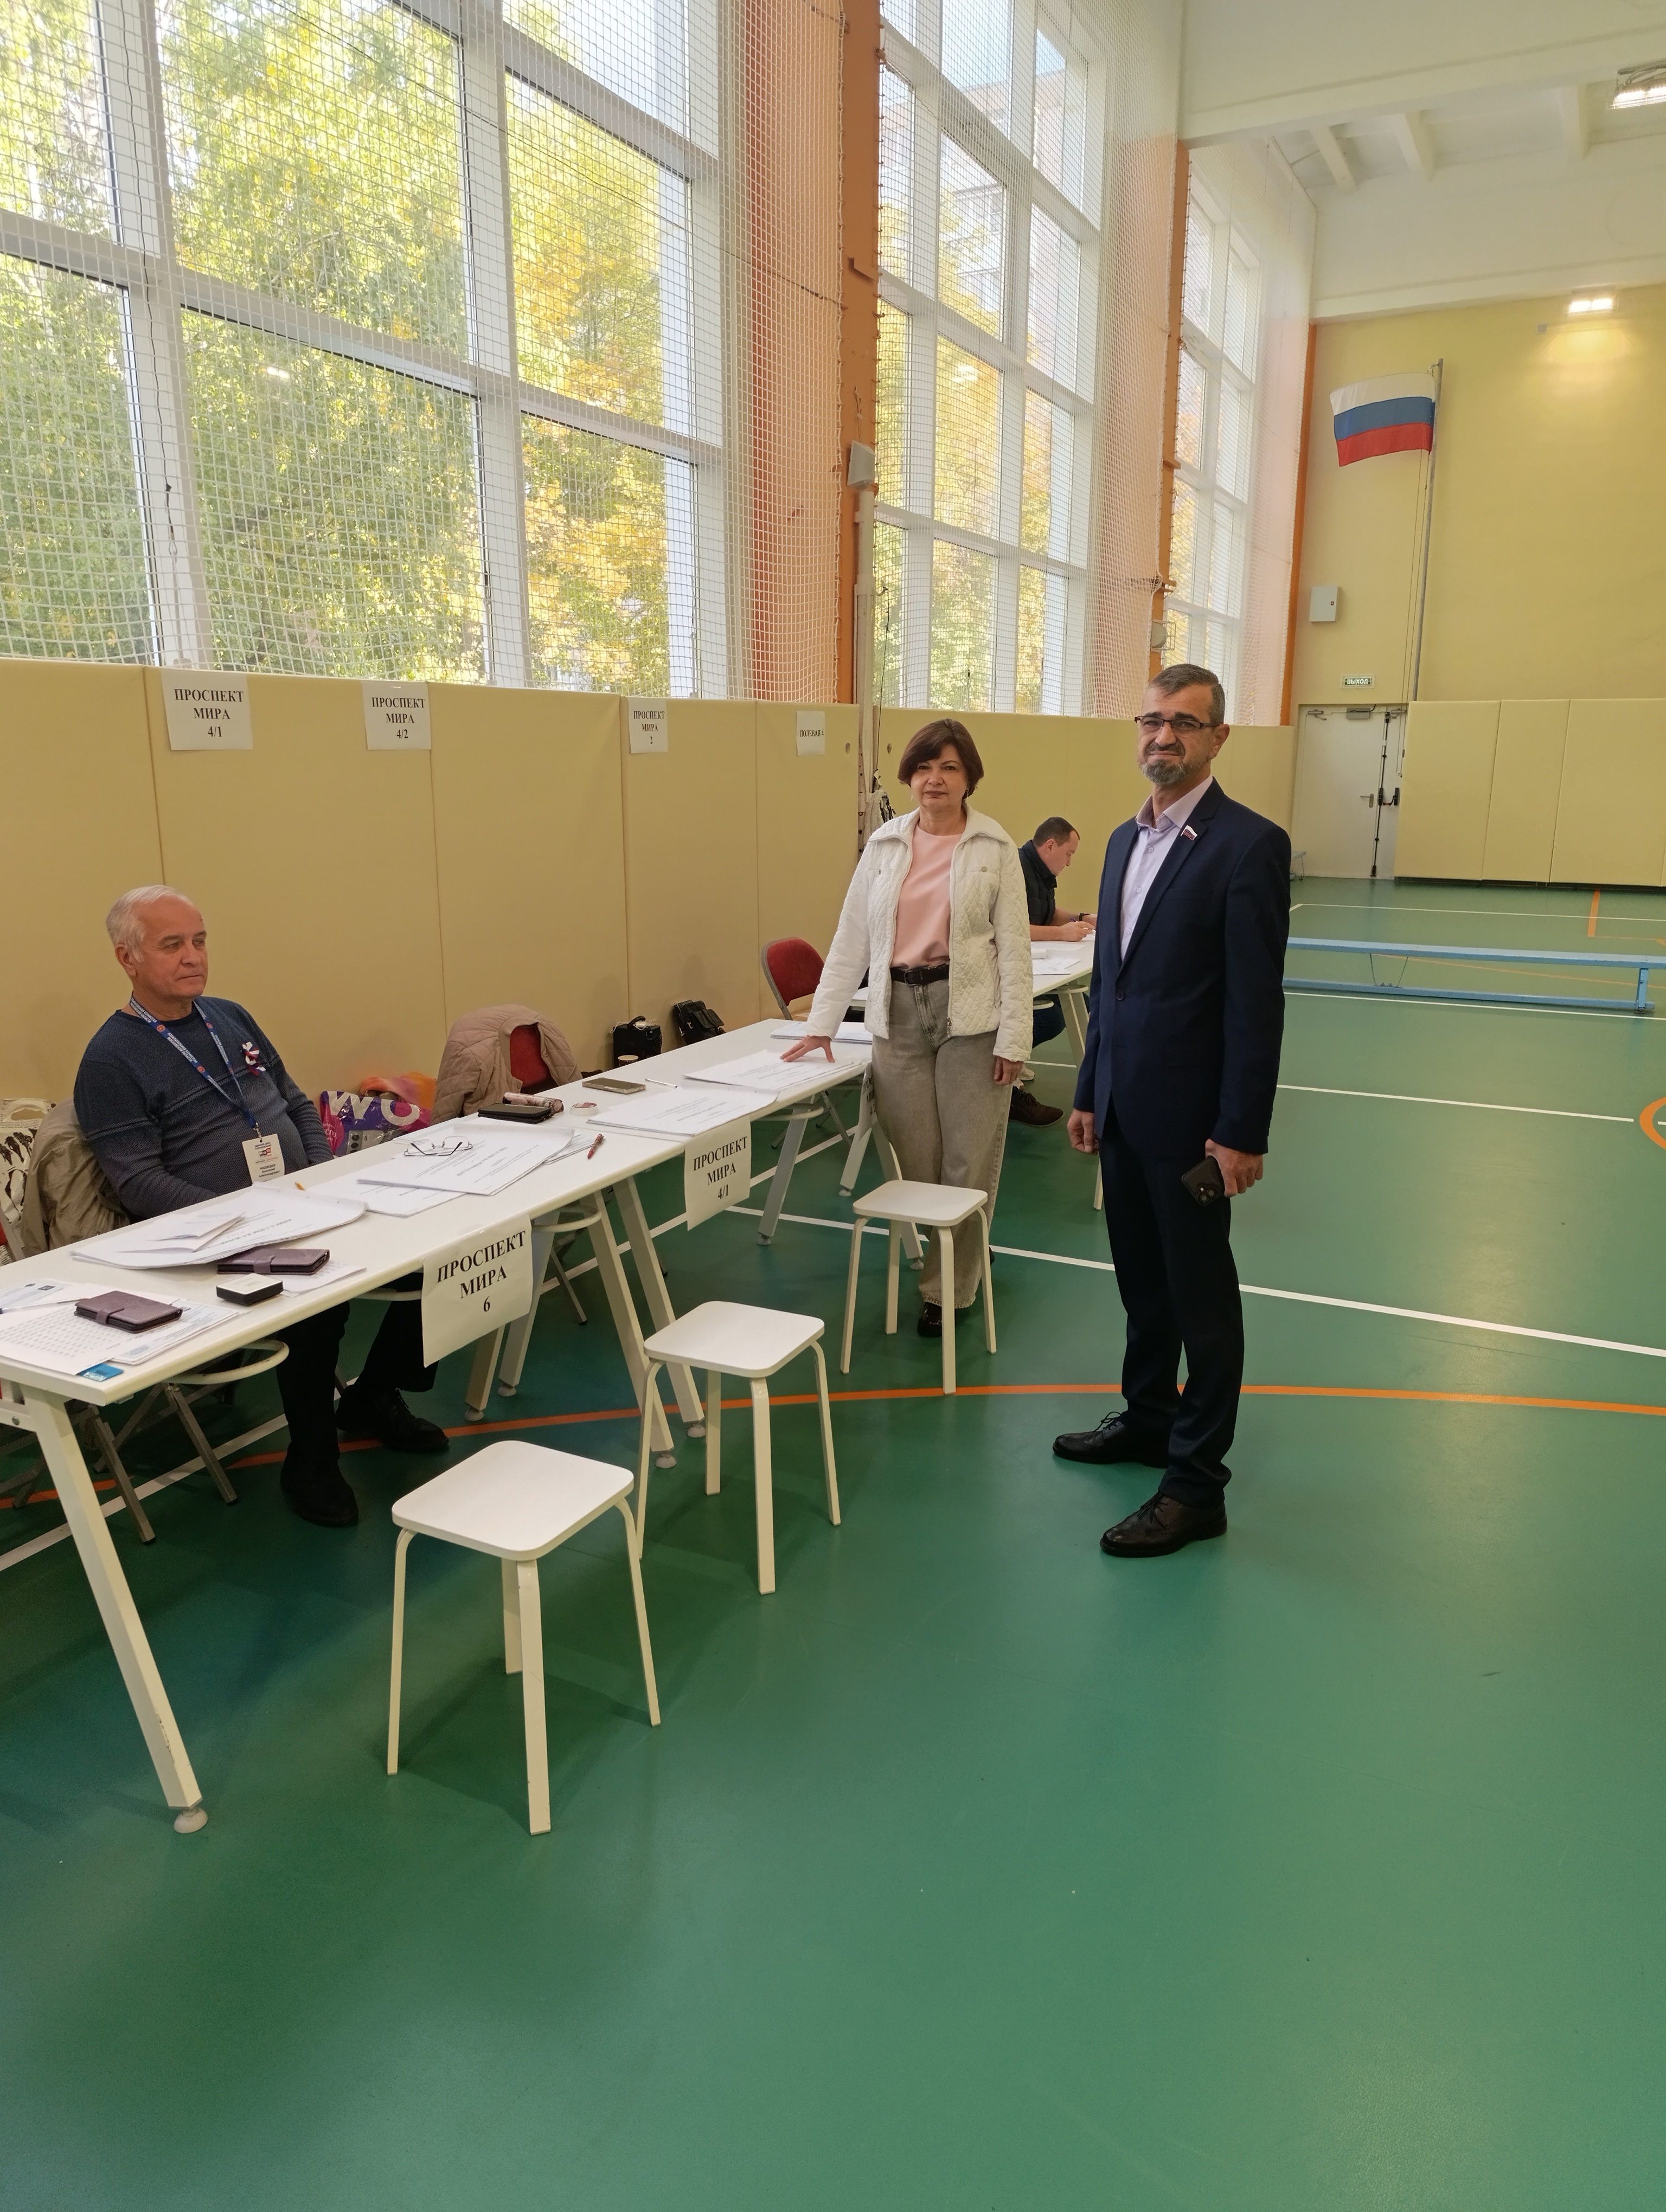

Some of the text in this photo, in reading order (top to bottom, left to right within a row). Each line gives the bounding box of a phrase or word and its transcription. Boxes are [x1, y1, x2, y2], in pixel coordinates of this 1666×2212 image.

[174, 689, 244, 702] ПРОСПЕКТ
[371, 697, 425, 708] ПРОСПЕКТ
[193, 708, 230, 719] МИРА
[386, 713, 415, 723] МИРА
[633, 711, 665, 719] ПРОСПЕКТ
[208, 725, 222, 737] 4/1
[642, 723, 658, 731] МИРА
[396, 729, 408, 739] 4/2
[650, 736, 653, 744] 2
[694, 1136, 747, 1171] ПРОСПЕКТ
[707, 1162, 736, 1186] МИРА
[717, 1184, 728, 1199] 4/1
[437, 1230, 526, 1283] ПРОСПЕКТ
[460, 1265, 507, 1299] МИРА
[483, 1295, 490, 1312] 6
